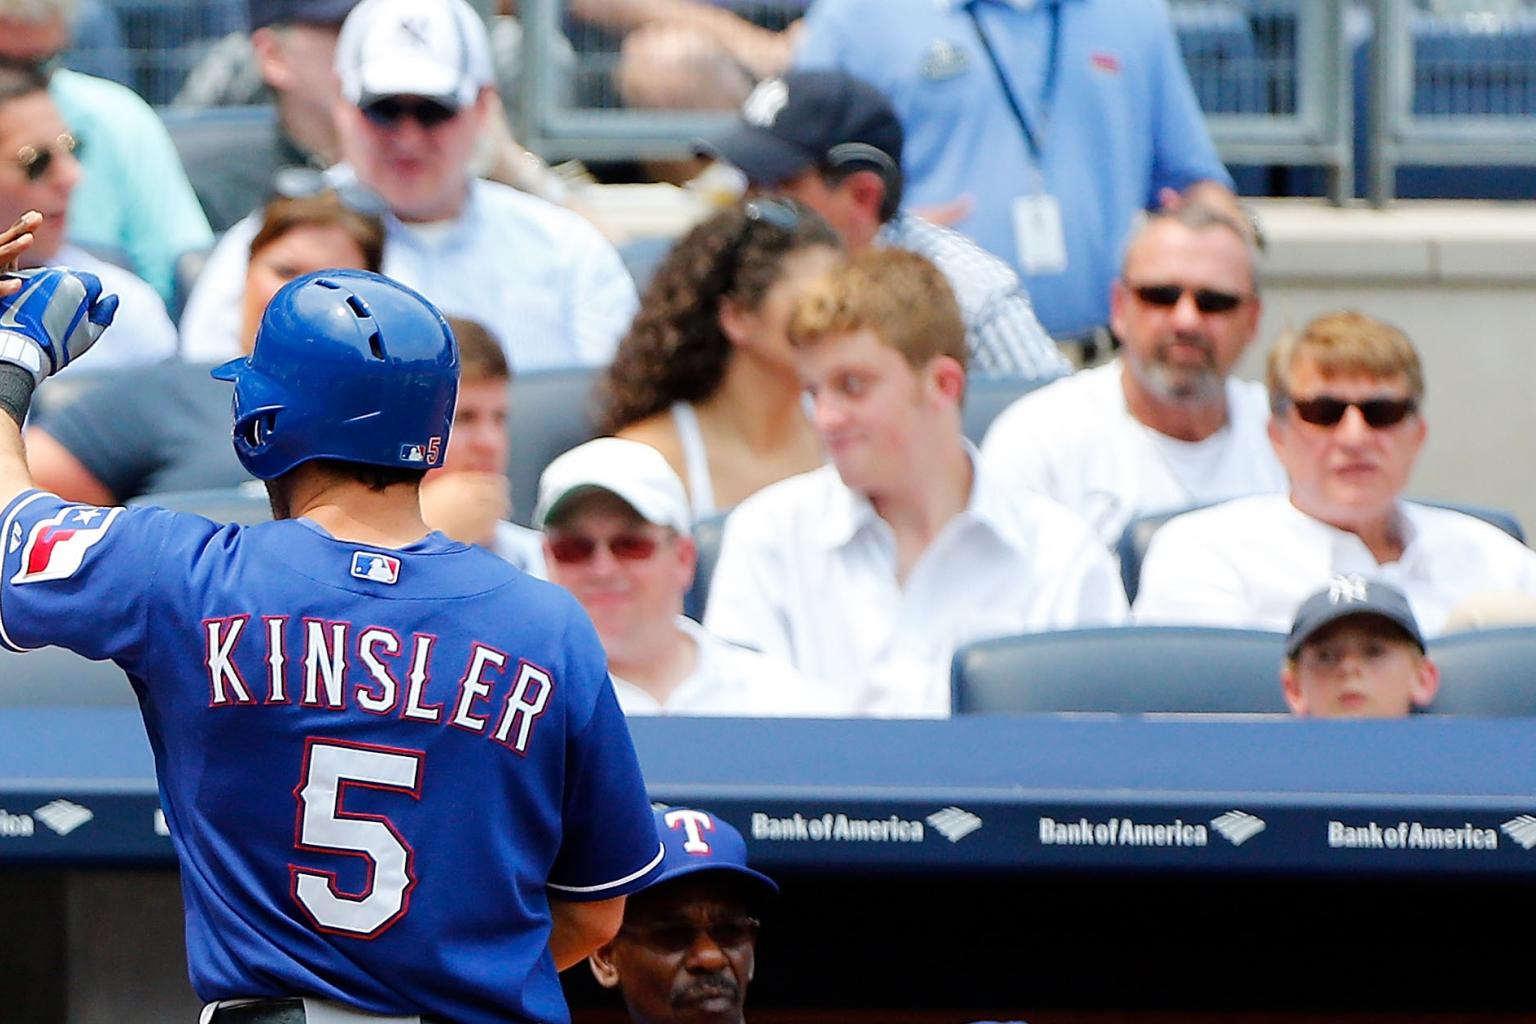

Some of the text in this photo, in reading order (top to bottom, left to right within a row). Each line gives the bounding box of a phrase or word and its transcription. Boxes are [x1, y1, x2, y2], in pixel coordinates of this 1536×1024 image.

[426, 436, 442, 465] 5
[202, 614, 554, 757] KINSLER
[288, 736, 427, 940] 5
[664, 809, 716, 857] T
